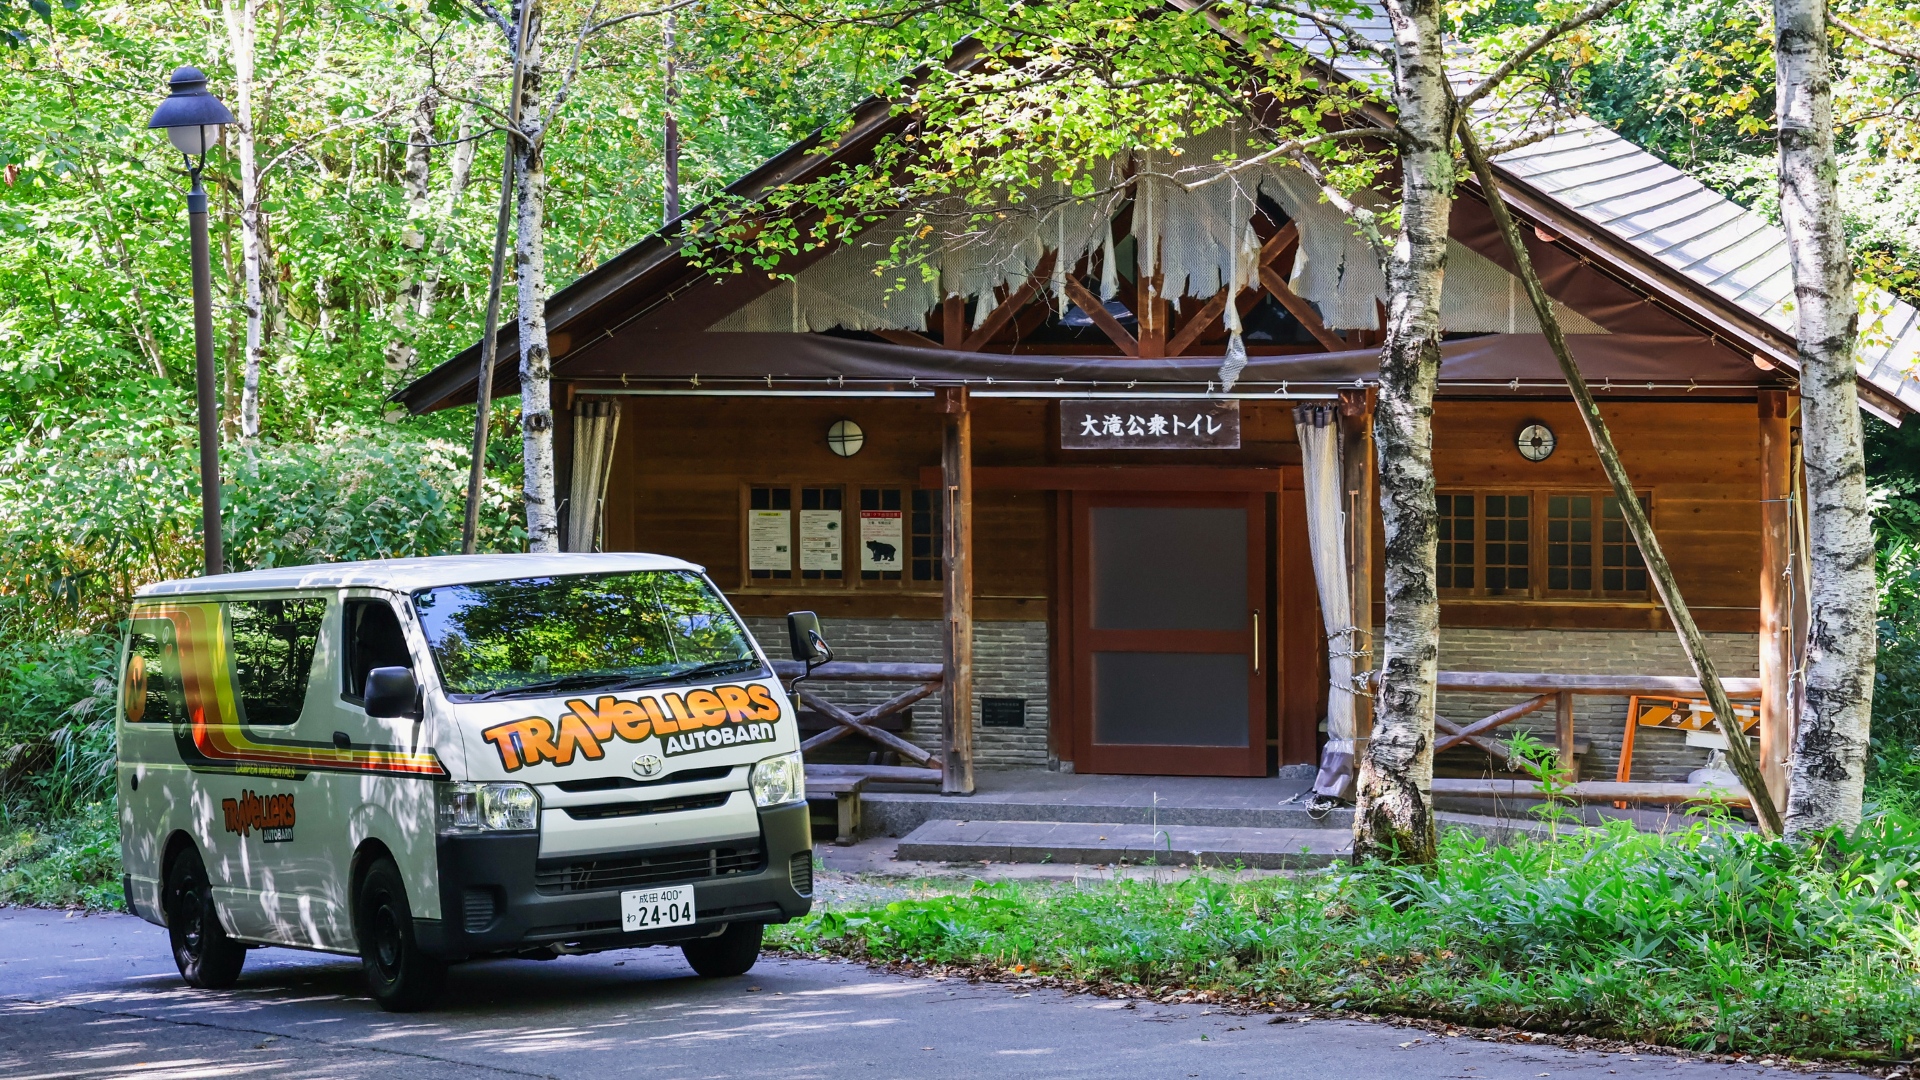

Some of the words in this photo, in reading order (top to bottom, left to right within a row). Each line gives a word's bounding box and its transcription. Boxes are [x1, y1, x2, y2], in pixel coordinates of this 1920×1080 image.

[1080, 413, 1222, 437] 大滝公衆トイレ
[235, 761, 258, 775] CAMPER
[258, 763, 270, 776] VAN
[270, 764, 296, 778] RENTALS
[639, 893, 658, 904] 成田
[660, 890, 679, 901] 400
[626, 913, 636, 923] わ
[638, 901, 691, 927] 24-04
